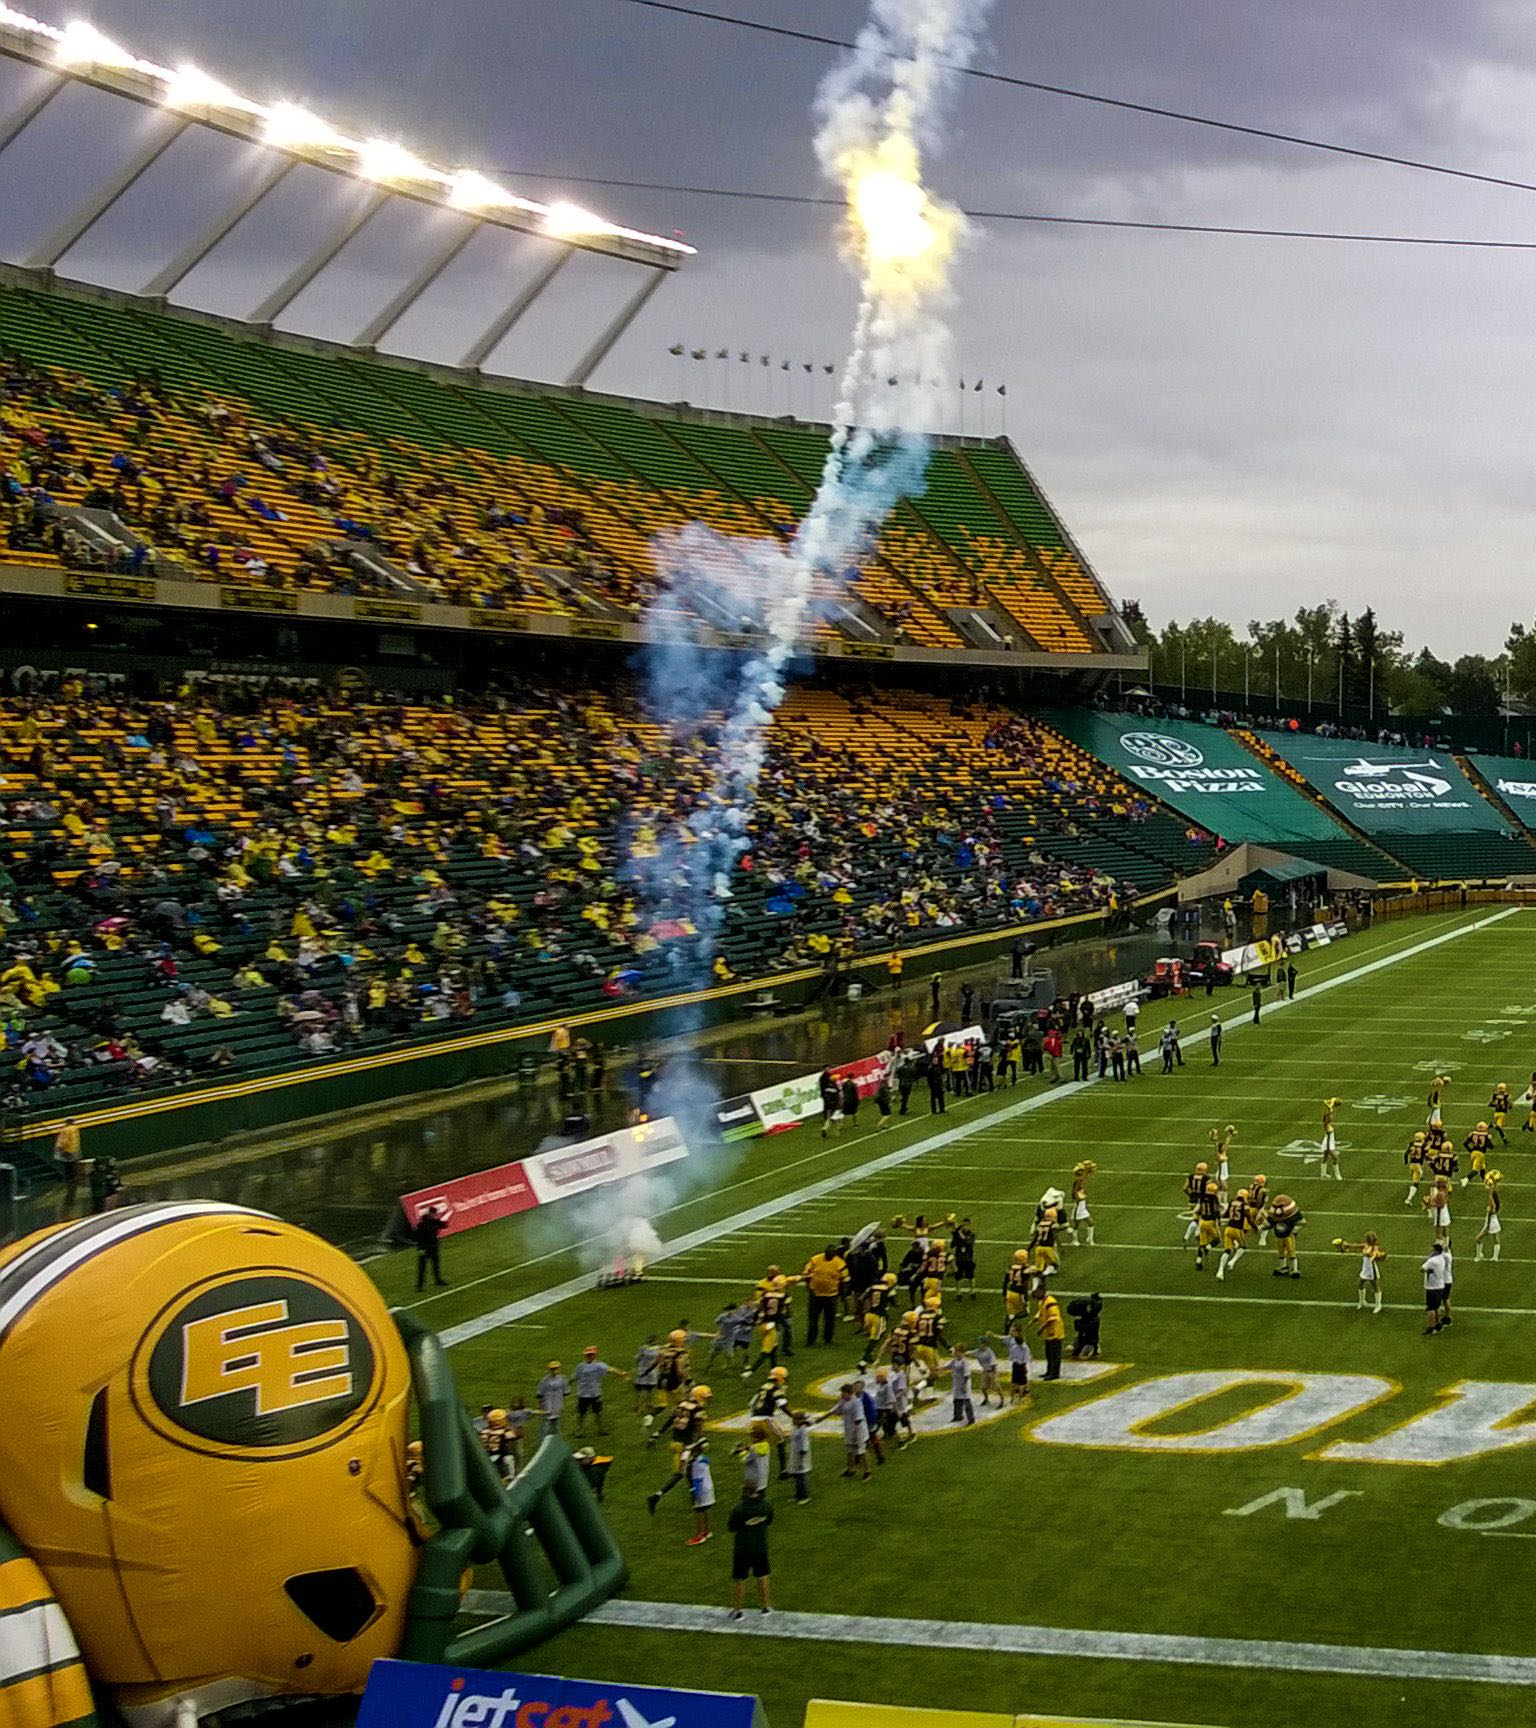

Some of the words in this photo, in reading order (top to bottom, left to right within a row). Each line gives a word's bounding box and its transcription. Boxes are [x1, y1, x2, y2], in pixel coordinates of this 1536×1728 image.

[1127, 765, 1263, 779] Boston
[1163, 779, 1267, 793] Pizza
[1334, 780, 1430, 793] Global
[1353, 791, 1436, 800] EDMONTON
[179, 1299, 354, 1416] EE
